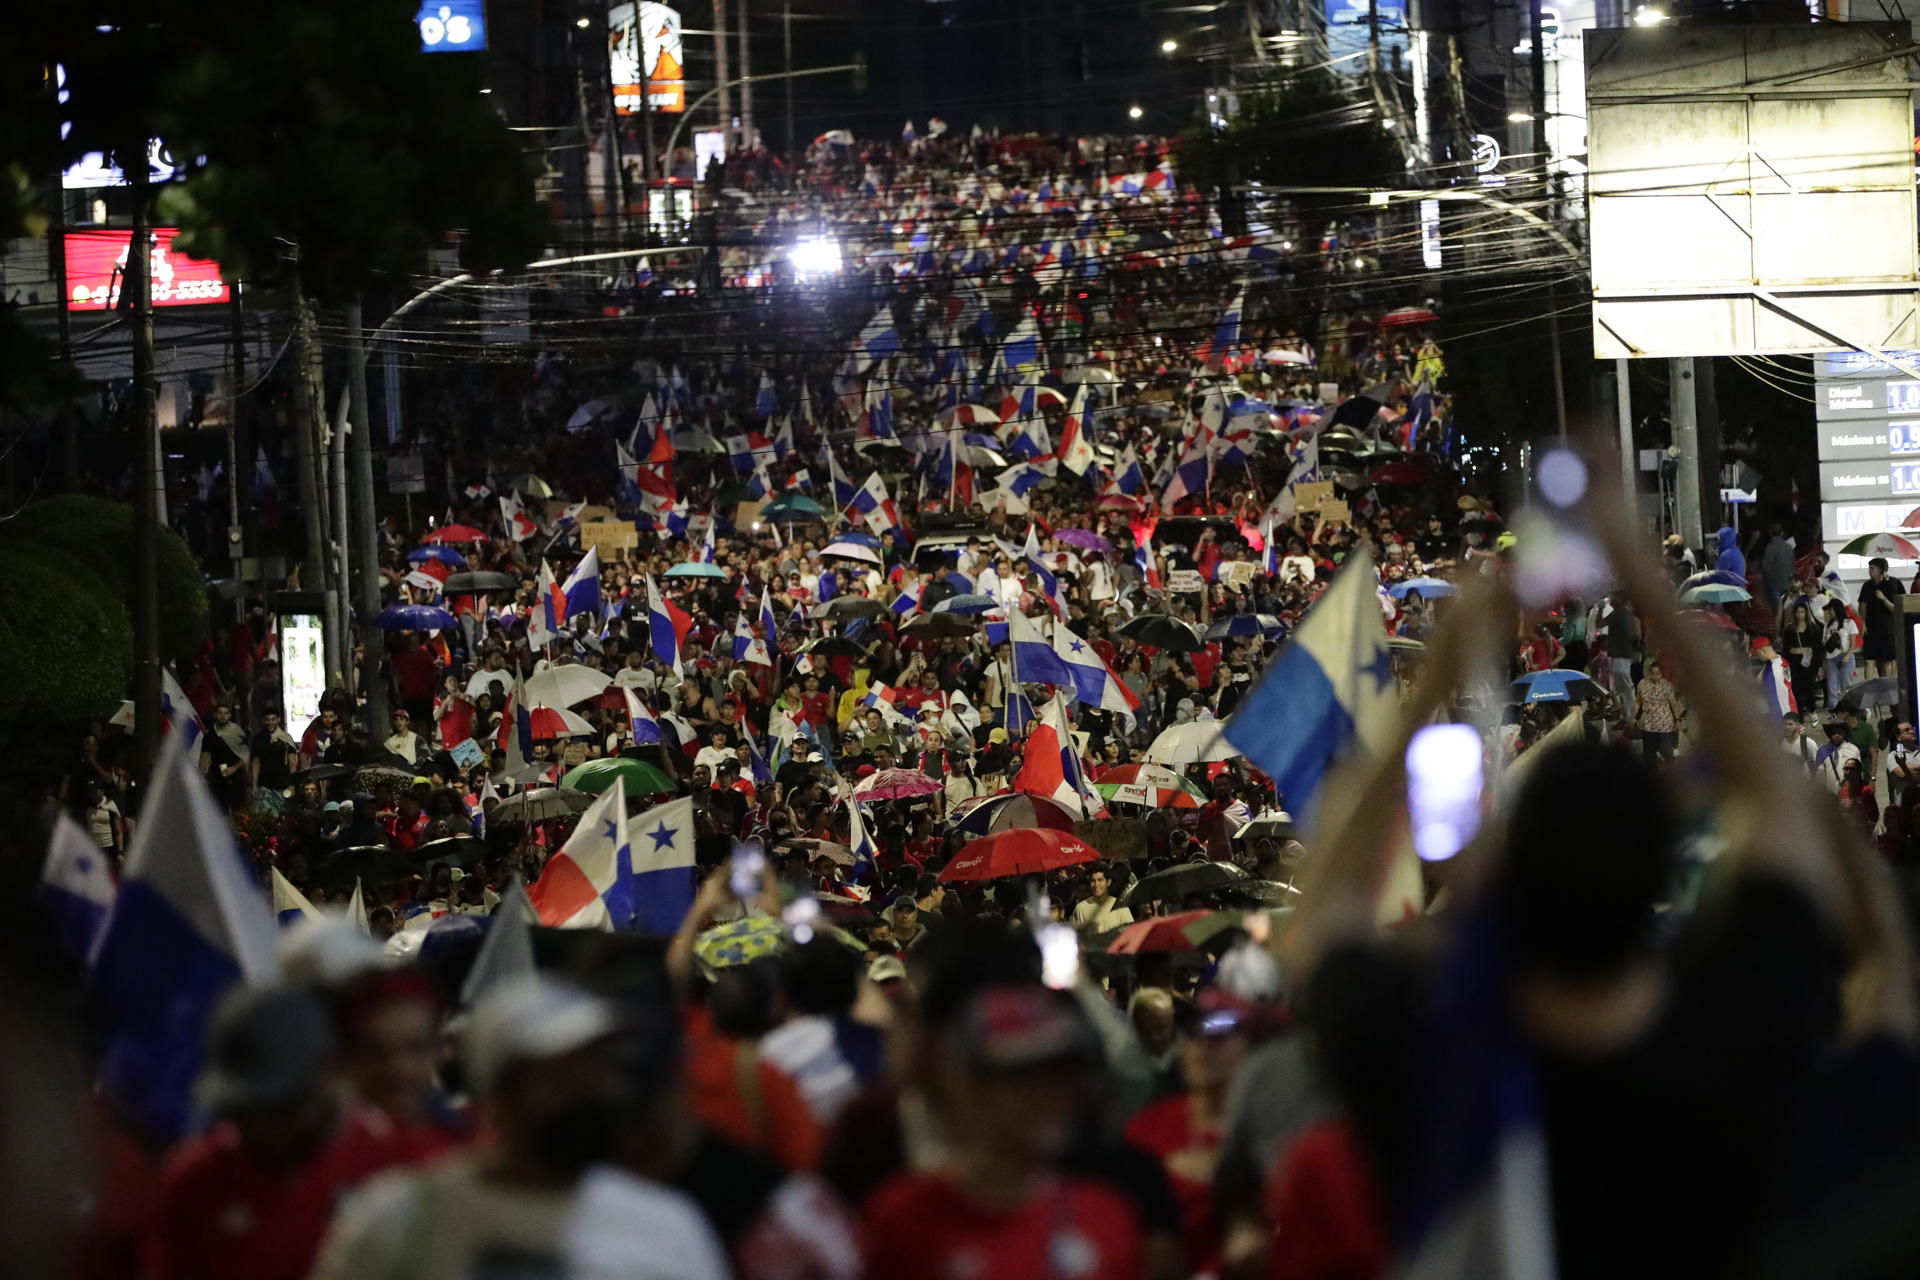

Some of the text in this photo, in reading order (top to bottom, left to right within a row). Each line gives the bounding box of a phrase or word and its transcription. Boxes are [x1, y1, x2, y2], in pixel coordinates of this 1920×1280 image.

[1829, 386, 1862, 398] Diesel
[1832, 435, 1874, 446] Máxima
[1876, 435, 1887, 444] 91
[1833, 475, 1876, 486] Máxima
